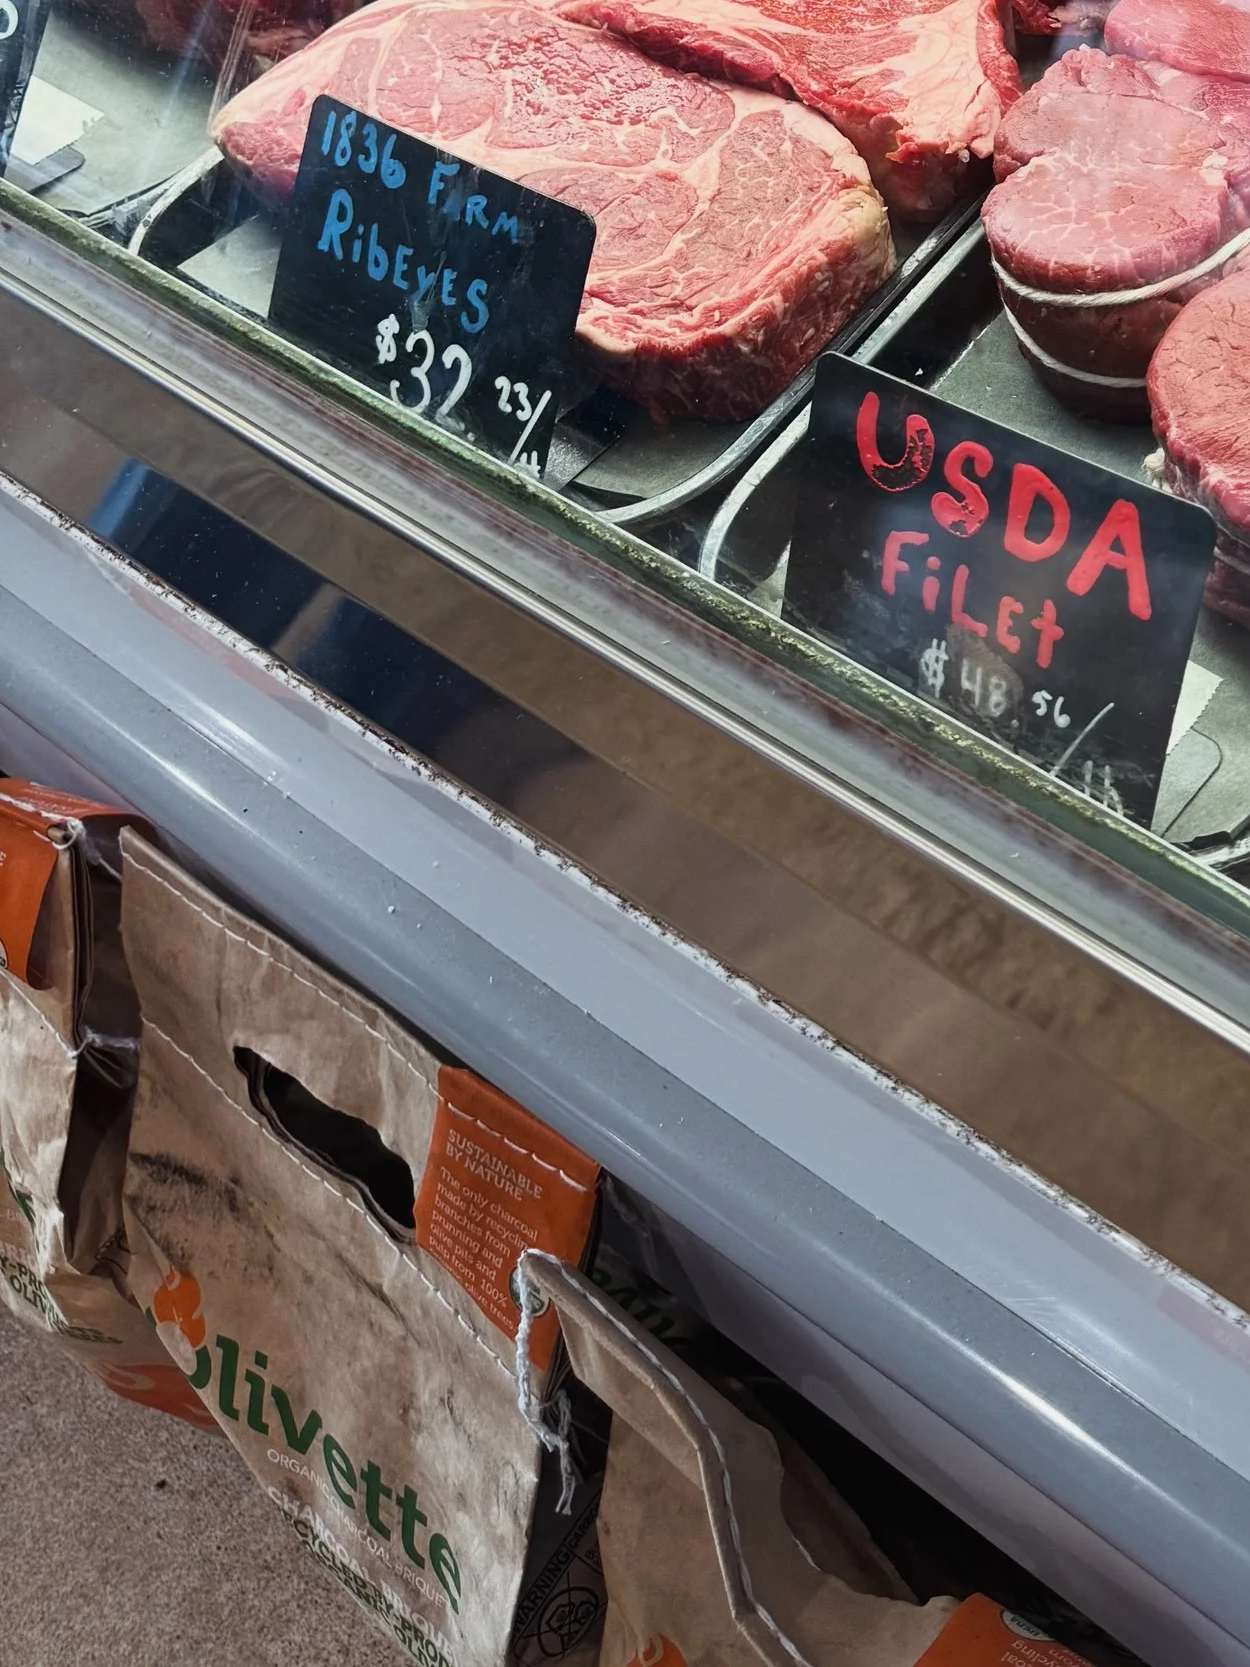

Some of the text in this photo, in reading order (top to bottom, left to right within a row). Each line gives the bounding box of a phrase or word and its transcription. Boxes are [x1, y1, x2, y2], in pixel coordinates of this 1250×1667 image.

[320, 110, 406, 189] 1836
[856, 390, 1152, 621] USDA
[445, 1143, 524, 1202] BY NATURE
[448, 1129, 543, 1199] SUSTAINABLE
[434, 1195, 511, 1258] branches from
[437, 1182, 529, 1251] made by recyclin
[440, 1166, 538, 1241] The only charcoal
[430, 1223, 453, 1248] olive
[455, 1245, 475, 1265] pits
[476, 1262, 497, 1282] and
[451, 1256, 476, 1282] from
[481, 1280, 508, 1308] 100%
[482, 1247, 504, 1268] and
